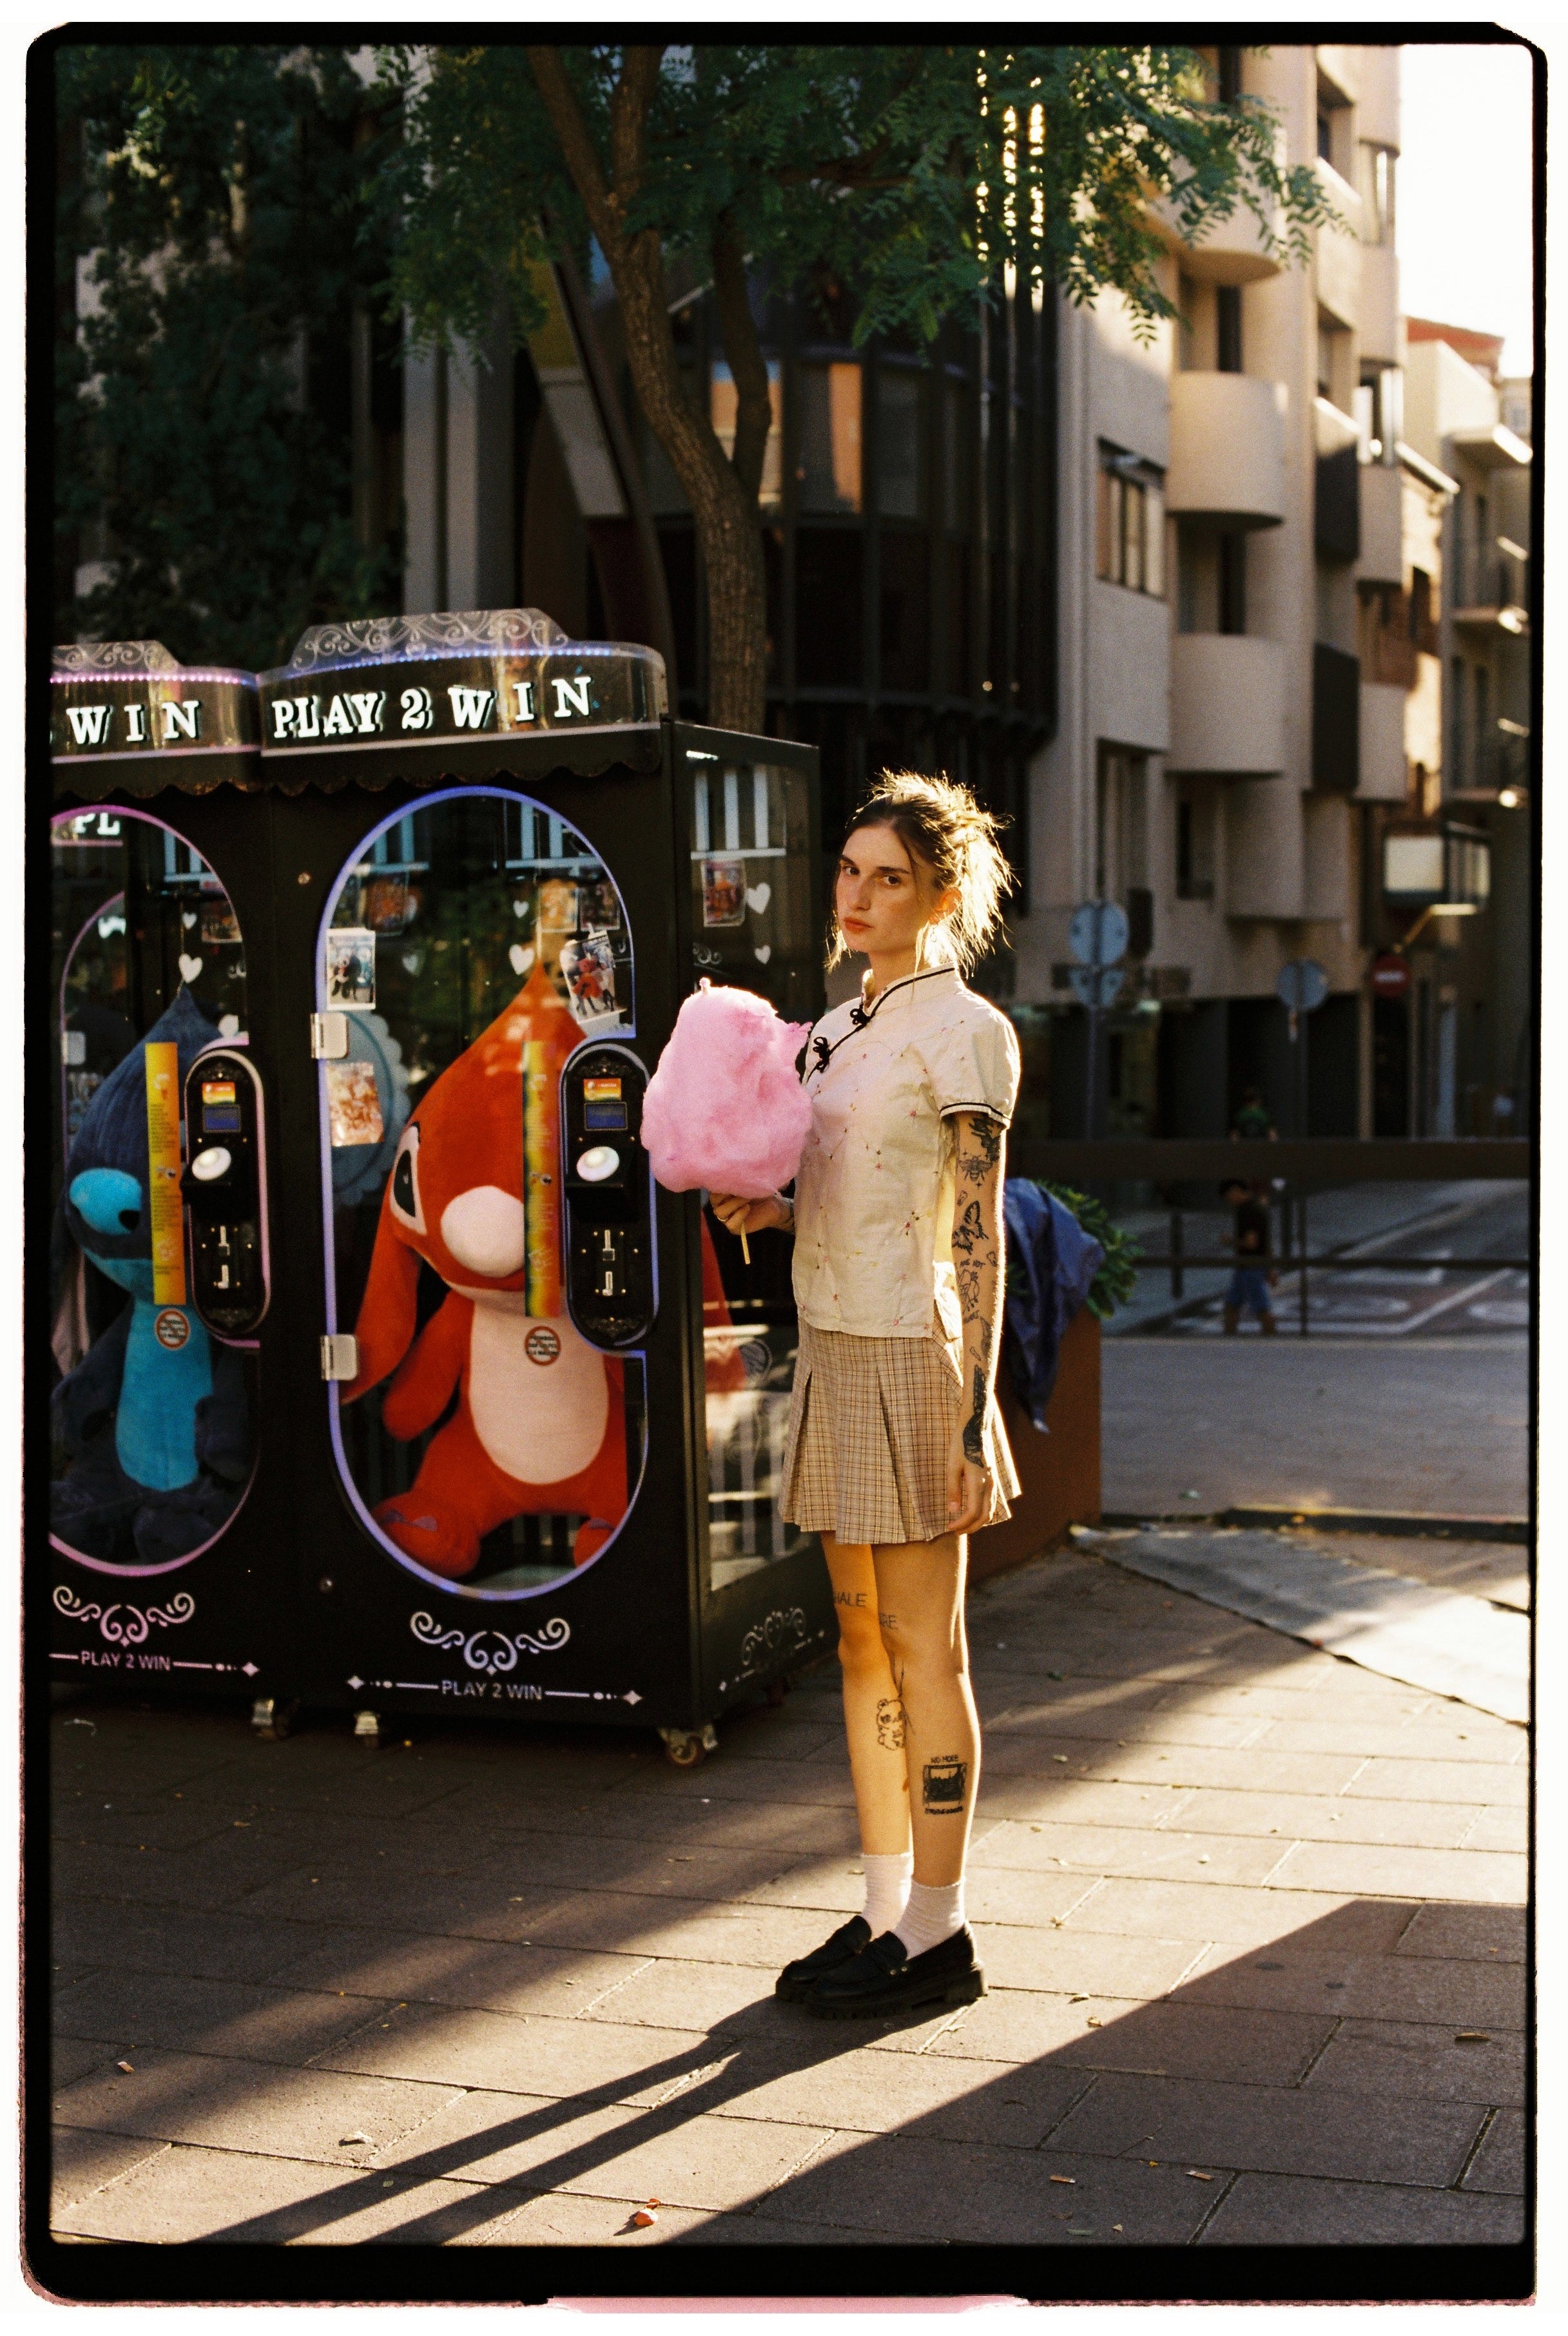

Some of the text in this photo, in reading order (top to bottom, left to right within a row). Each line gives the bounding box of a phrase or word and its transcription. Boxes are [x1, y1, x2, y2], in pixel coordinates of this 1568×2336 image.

[66, 700, 202, 744] WIN
[272, 676, 594, 738] PLAY 2 WIN
[81, 1650, 171, 1671] PLAY 2 WIN
[441, 1679, 543, 1700] PLAY 2 WIN
